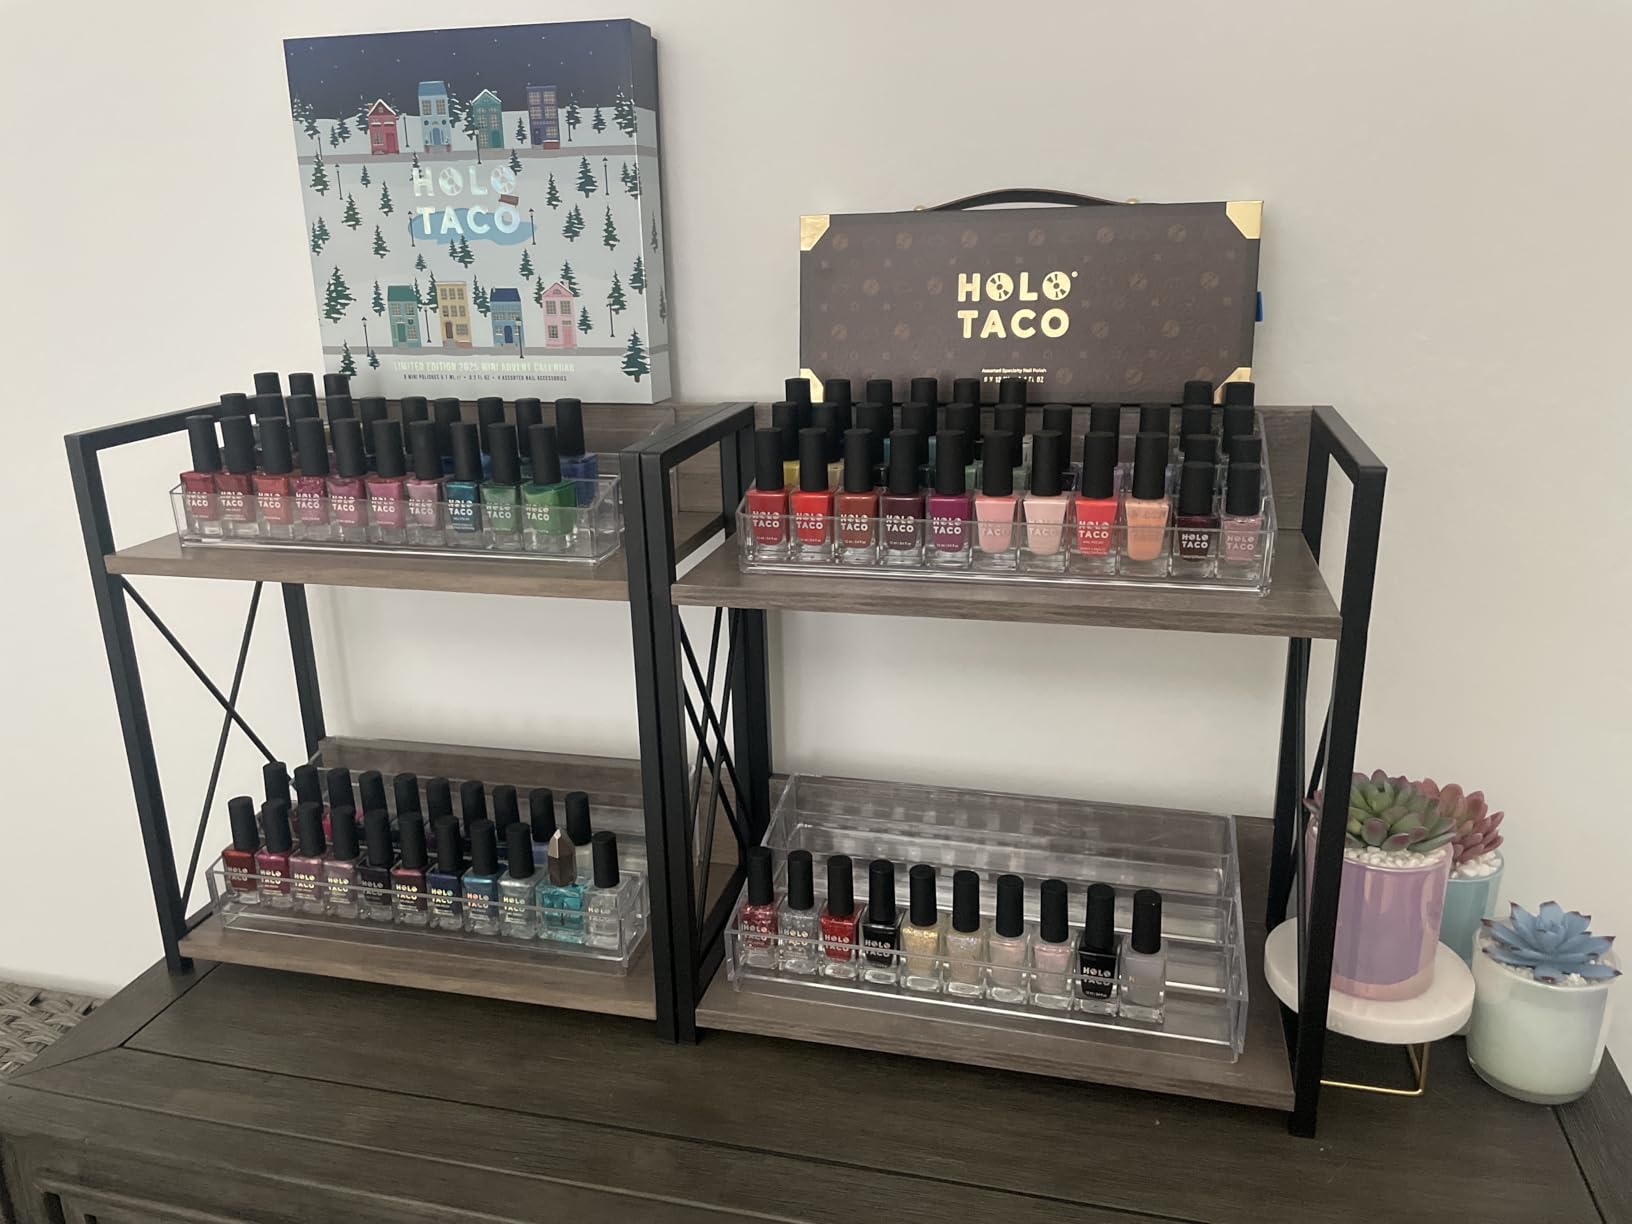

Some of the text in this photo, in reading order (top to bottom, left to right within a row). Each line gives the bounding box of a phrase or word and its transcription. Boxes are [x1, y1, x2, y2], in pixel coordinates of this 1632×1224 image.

[412, 165, 516, 197] HOLO
[416, 205, 520, 235] TACO
[958, 271, 1071, 302] HOLO
[958, 308, 1070, 338] TACO
[393, 362, 424, 372] LIMITED
[426, 362, 456, 372] EDITION
[526, 512, 550, 521] TACO
[840, 523, 868, 531] TACO
[886, 524, 914, 532] TACO
[933, 526, 961, 534] TACO
[1079, 530, 1109, 538] TACO
[396, 884, 418, 892] HOLO
[432, 888, 453, 896] HOLO
[467, 893, 489, 901] HOLO
[784, 929, 808, 937] HOLO
[824, 934, 850, 943] HOLO
[865, 939, 891, 949] HOLO
[1083, 966, 1111, 976] HOLO
